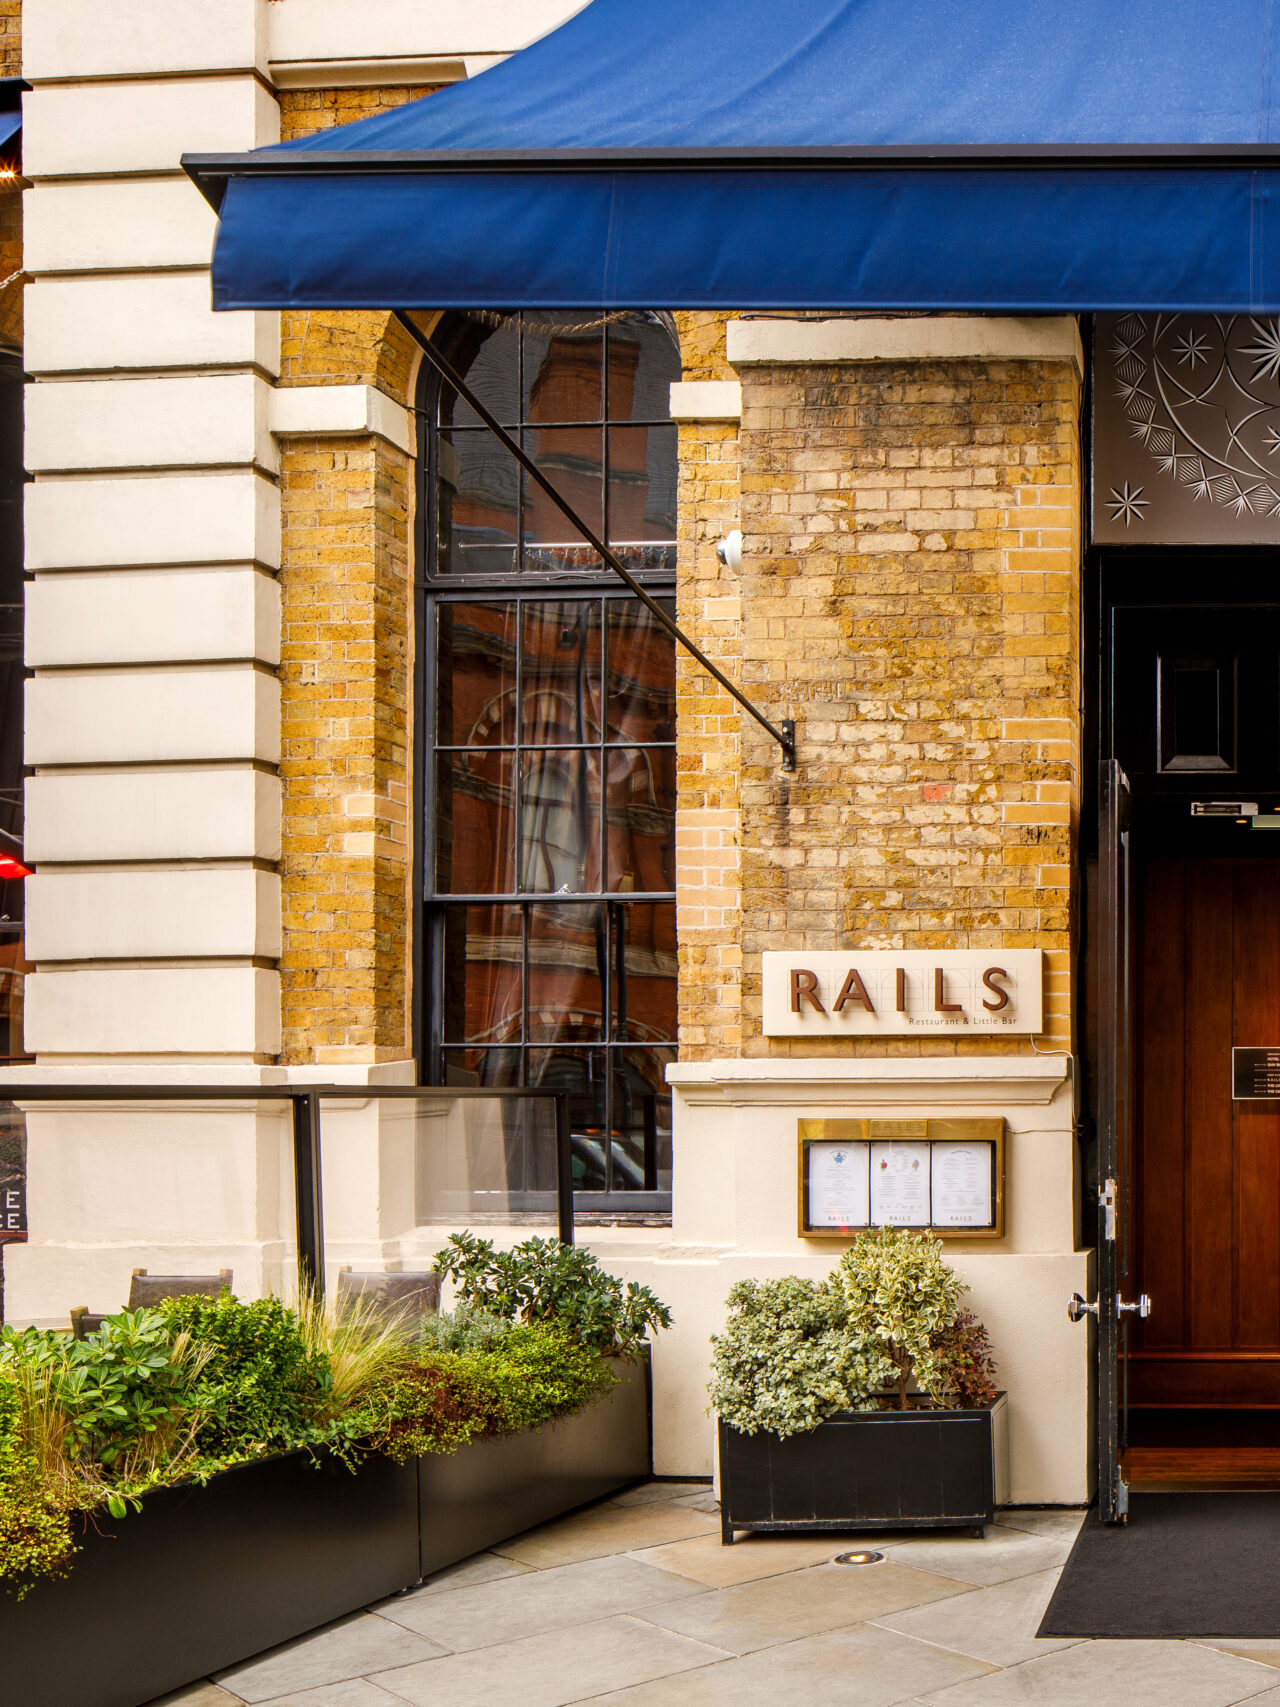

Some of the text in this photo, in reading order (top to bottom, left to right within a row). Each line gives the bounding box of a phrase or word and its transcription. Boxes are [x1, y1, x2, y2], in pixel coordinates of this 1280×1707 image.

[789, 966, 1009, 1013] RAILS
[909, 1016, 1017, 1026] Restaurant & Little Bar
[0, 1212, 20, 1229] E
